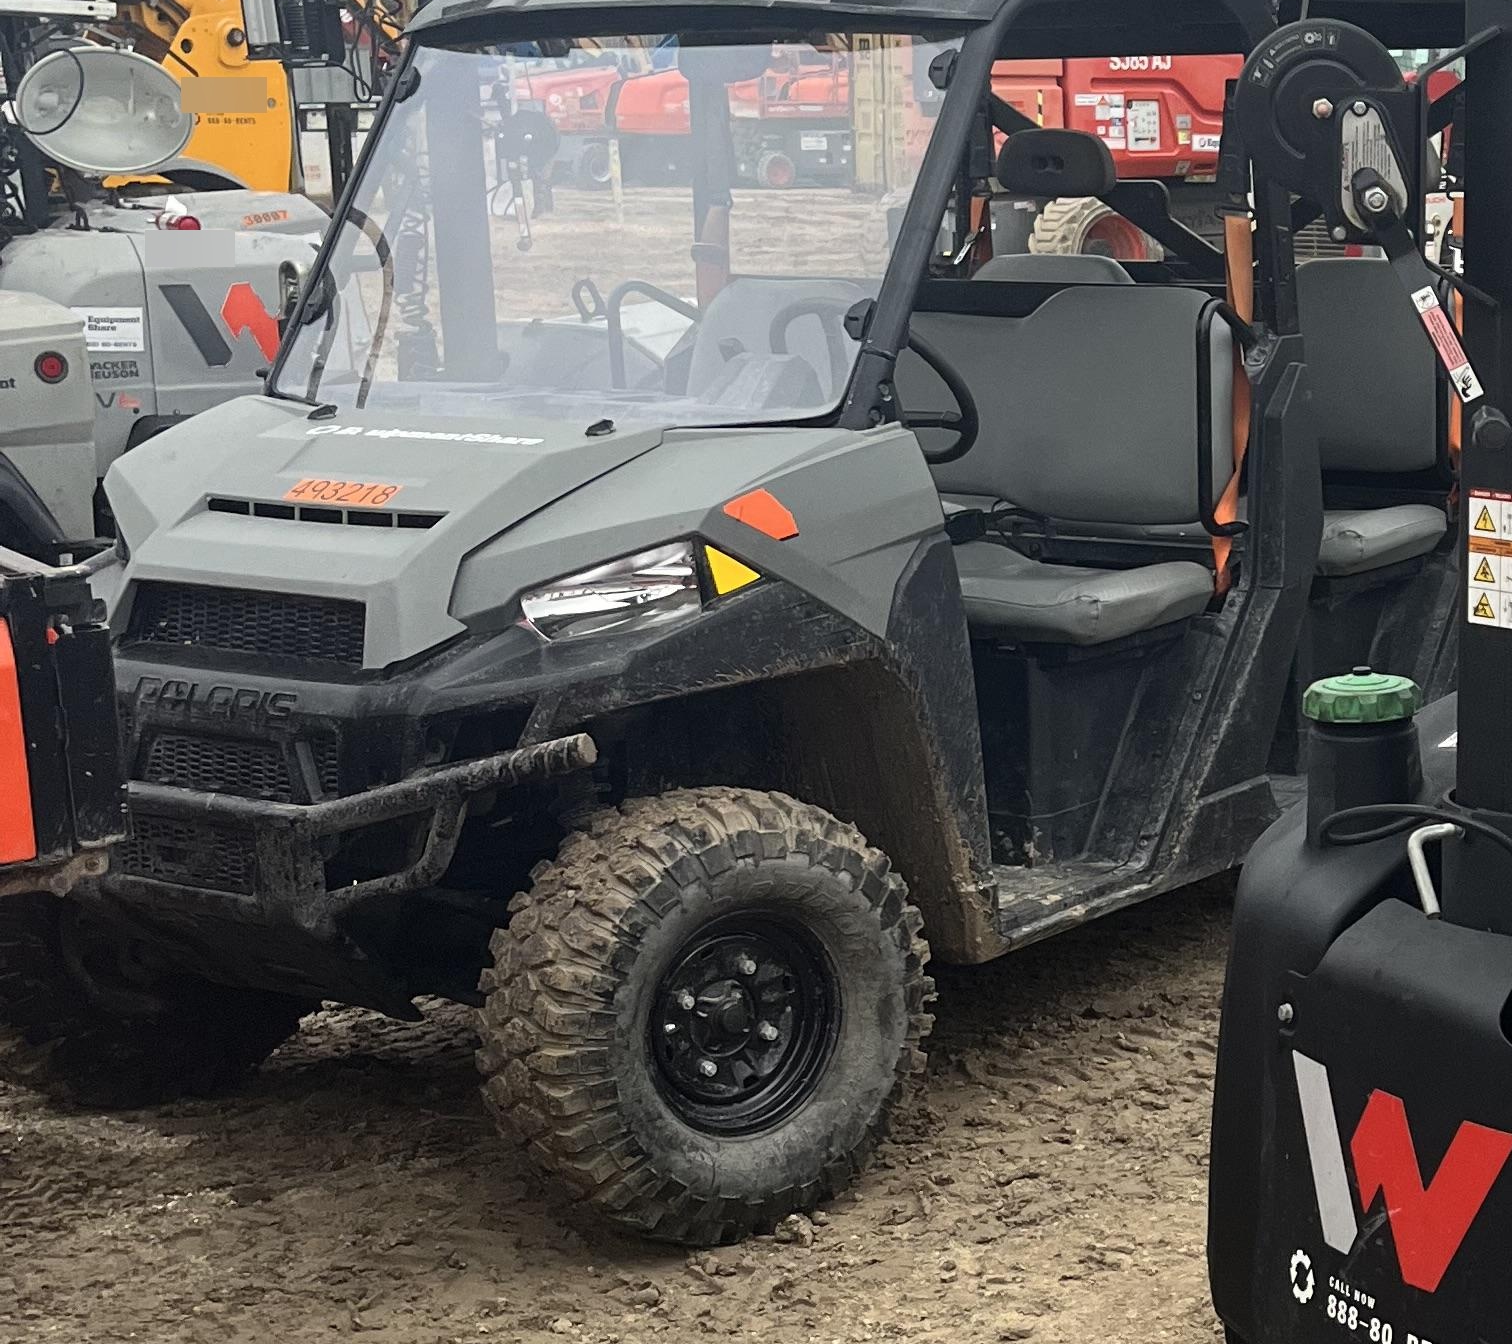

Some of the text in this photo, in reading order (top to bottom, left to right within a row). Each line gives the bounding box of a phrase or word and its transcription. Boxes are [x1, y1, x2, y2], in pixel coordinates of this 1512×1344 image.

[291, 479, 398, 506] 493218
[134, 676, 298, 718] POLARIS
[1329, 1275, 1376, 1310] CALL NOW
